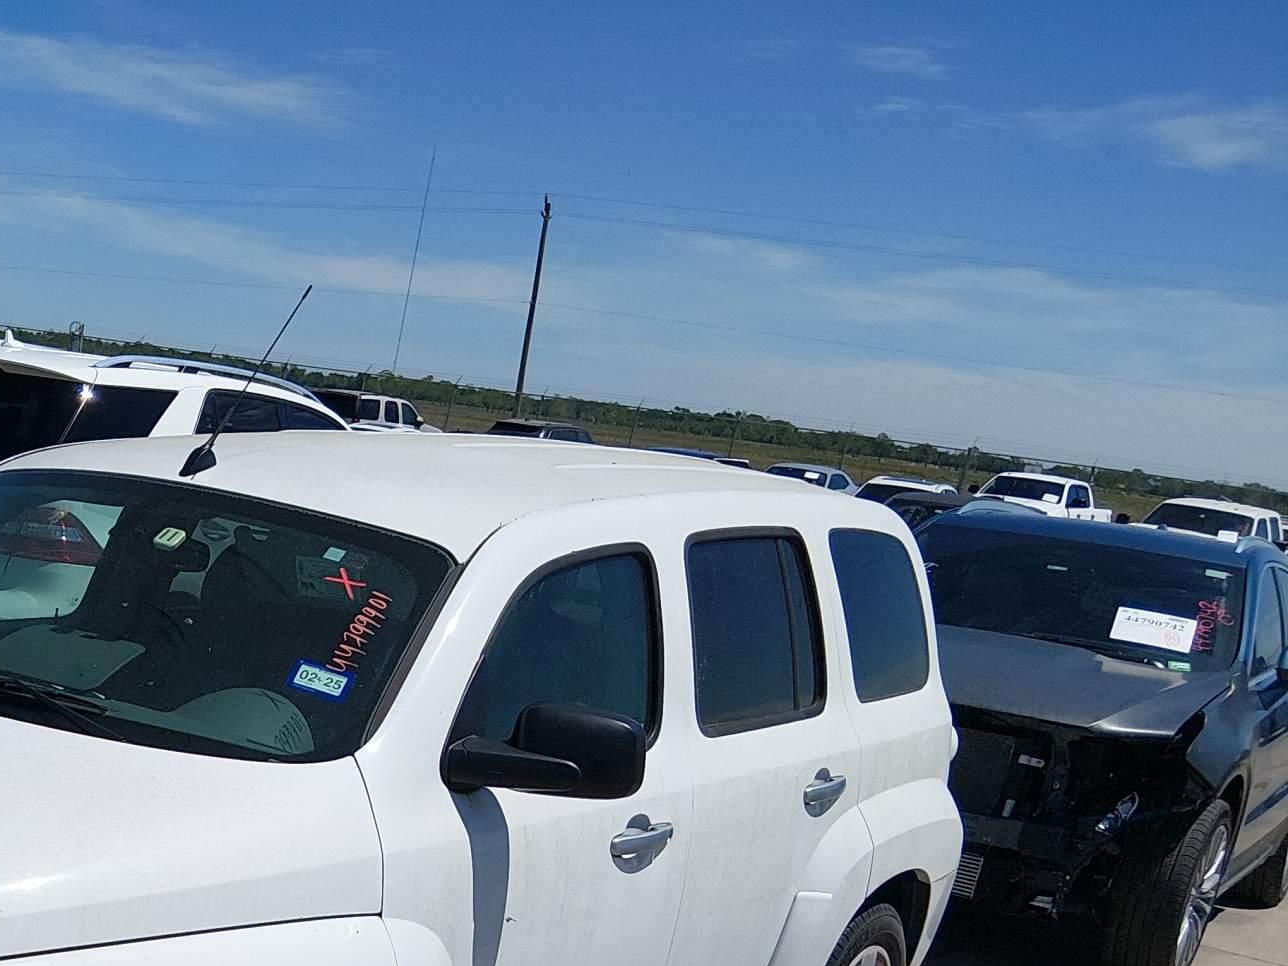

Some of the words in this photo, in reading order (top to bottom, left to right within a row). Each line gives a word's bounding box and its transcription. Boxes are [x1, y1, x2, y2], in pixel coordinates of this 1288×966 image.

[325, 590, 393, 672] 44799901
[1123, 615, 1185, 632] 44790742
[299, 669, 318, 683] 02
[323, 677, 344, 691] 25
